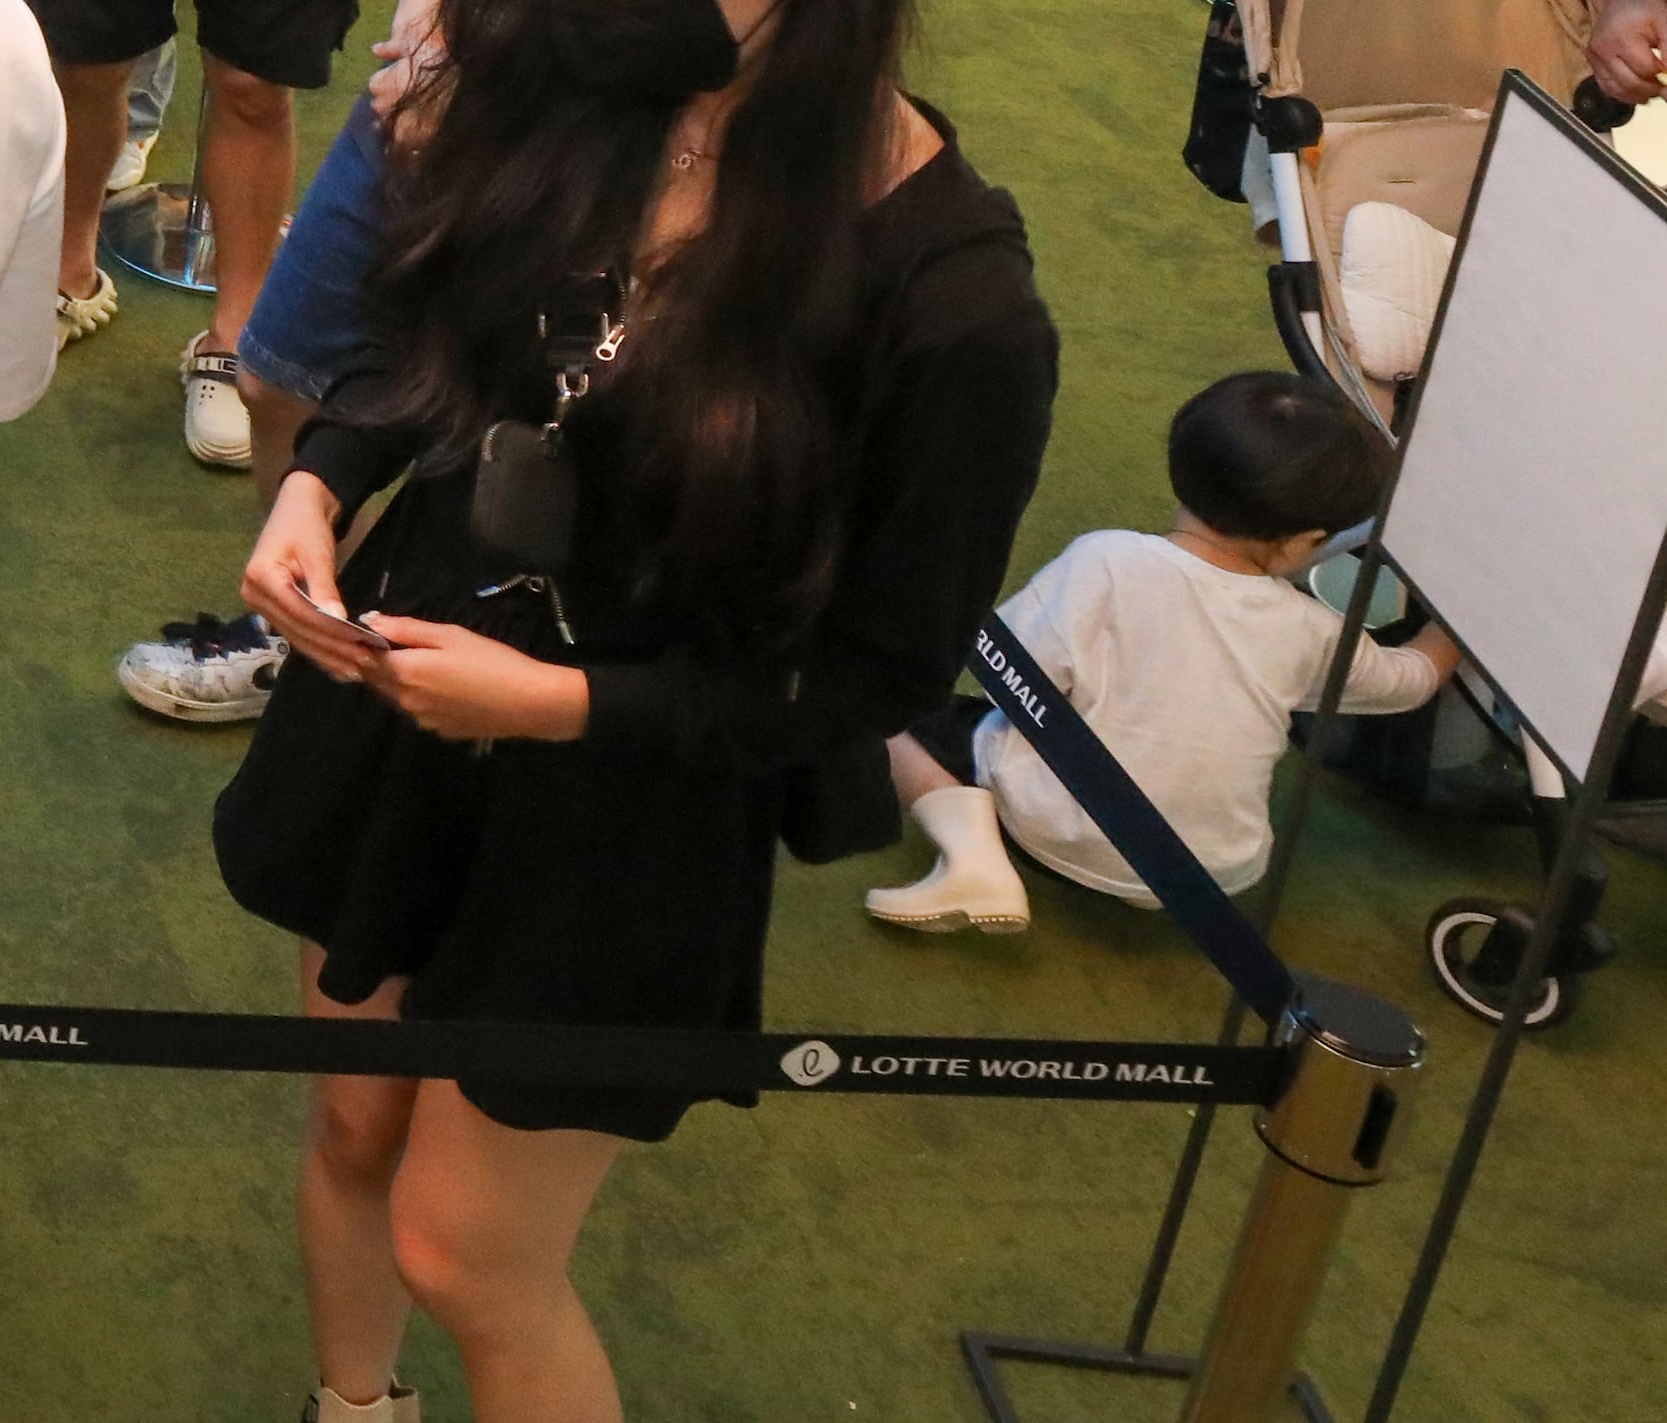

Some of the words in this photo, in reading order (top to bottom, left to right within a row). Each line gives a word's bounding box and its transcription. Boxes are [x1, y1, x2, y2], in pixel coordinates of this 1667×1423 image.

[976, 628, 1007, 672] RLD
[1001, 666, 1047, 728] MALL
[850, 1055, 970, 1077] LOTTE
[978, 1059, 1109, 1081] WORLD
[1114, 1063, 1215, 1086] MALL
